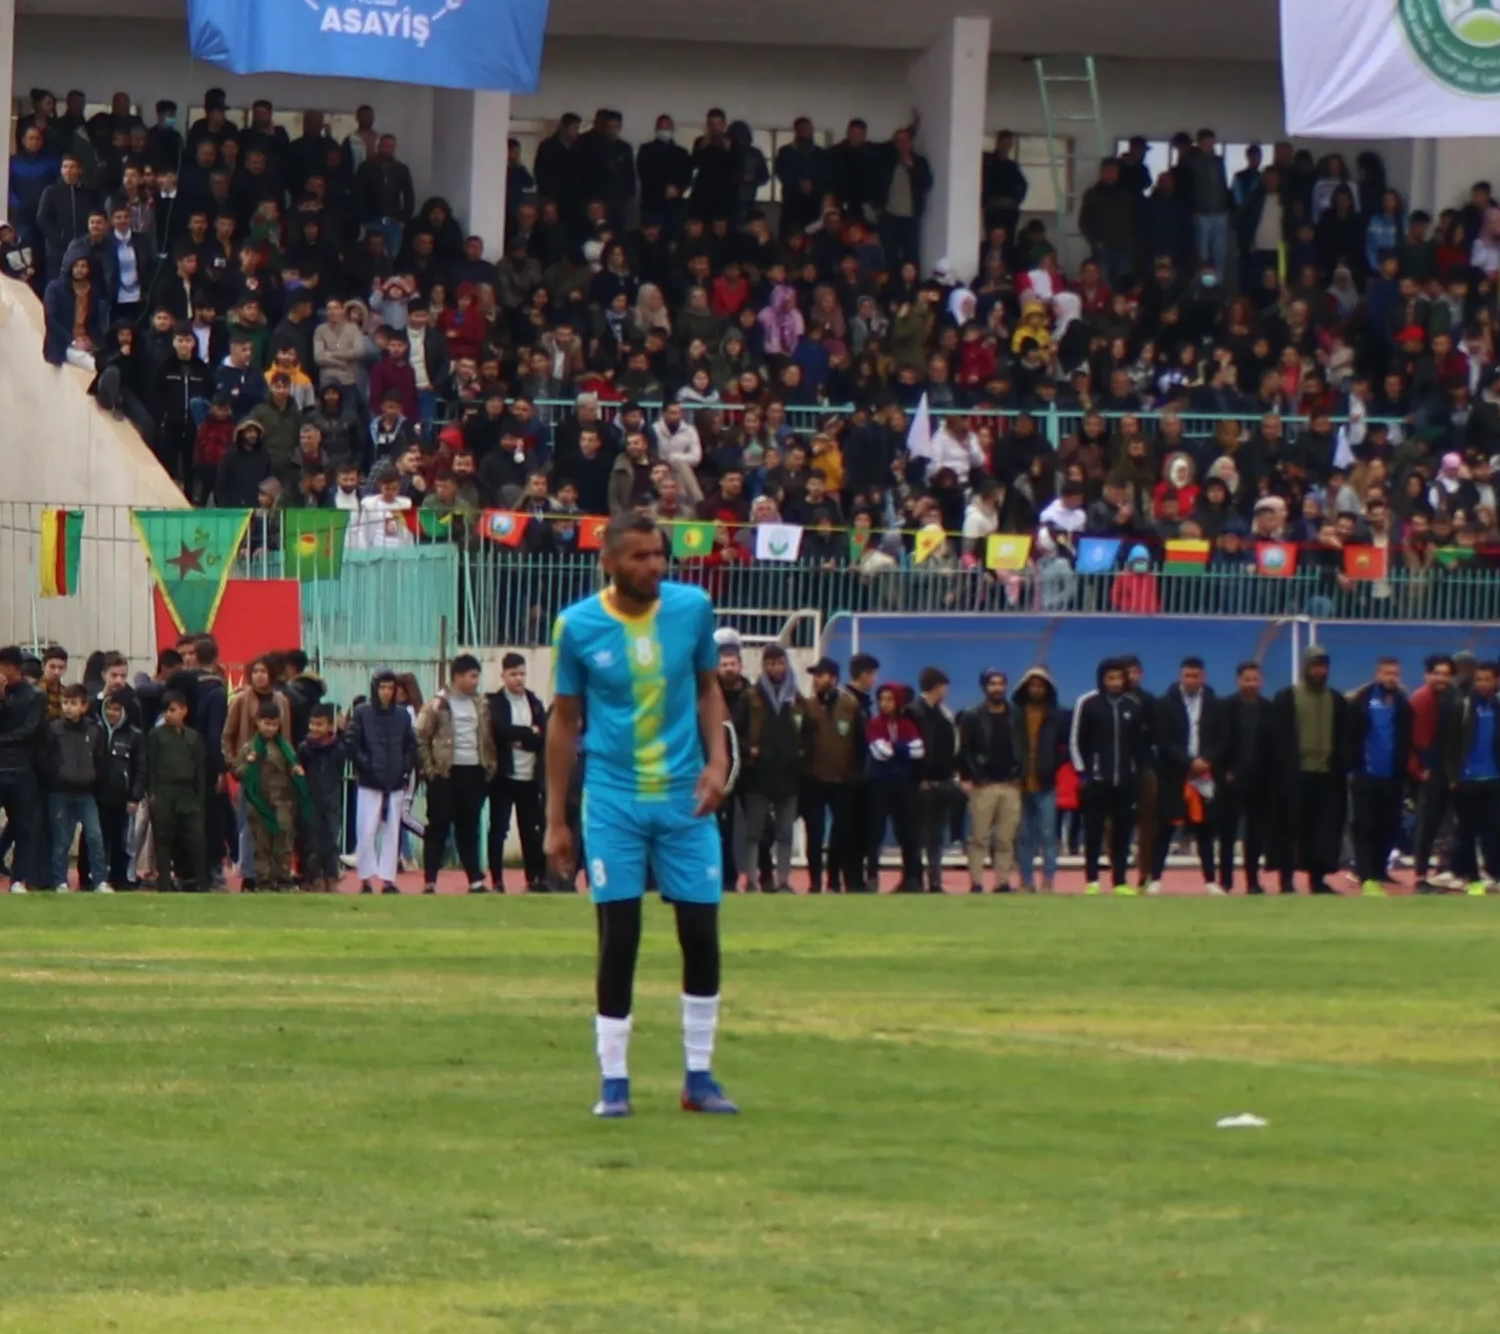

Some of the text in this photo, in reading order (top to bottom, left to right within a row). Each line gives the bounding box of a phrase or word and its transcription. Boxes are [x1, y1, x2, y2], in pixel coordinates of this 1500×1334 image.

[320, 4, 430, 48] ASAYİŞ
[635, 635, 653, 666] 8
[591, 857, 608, 889] 8
